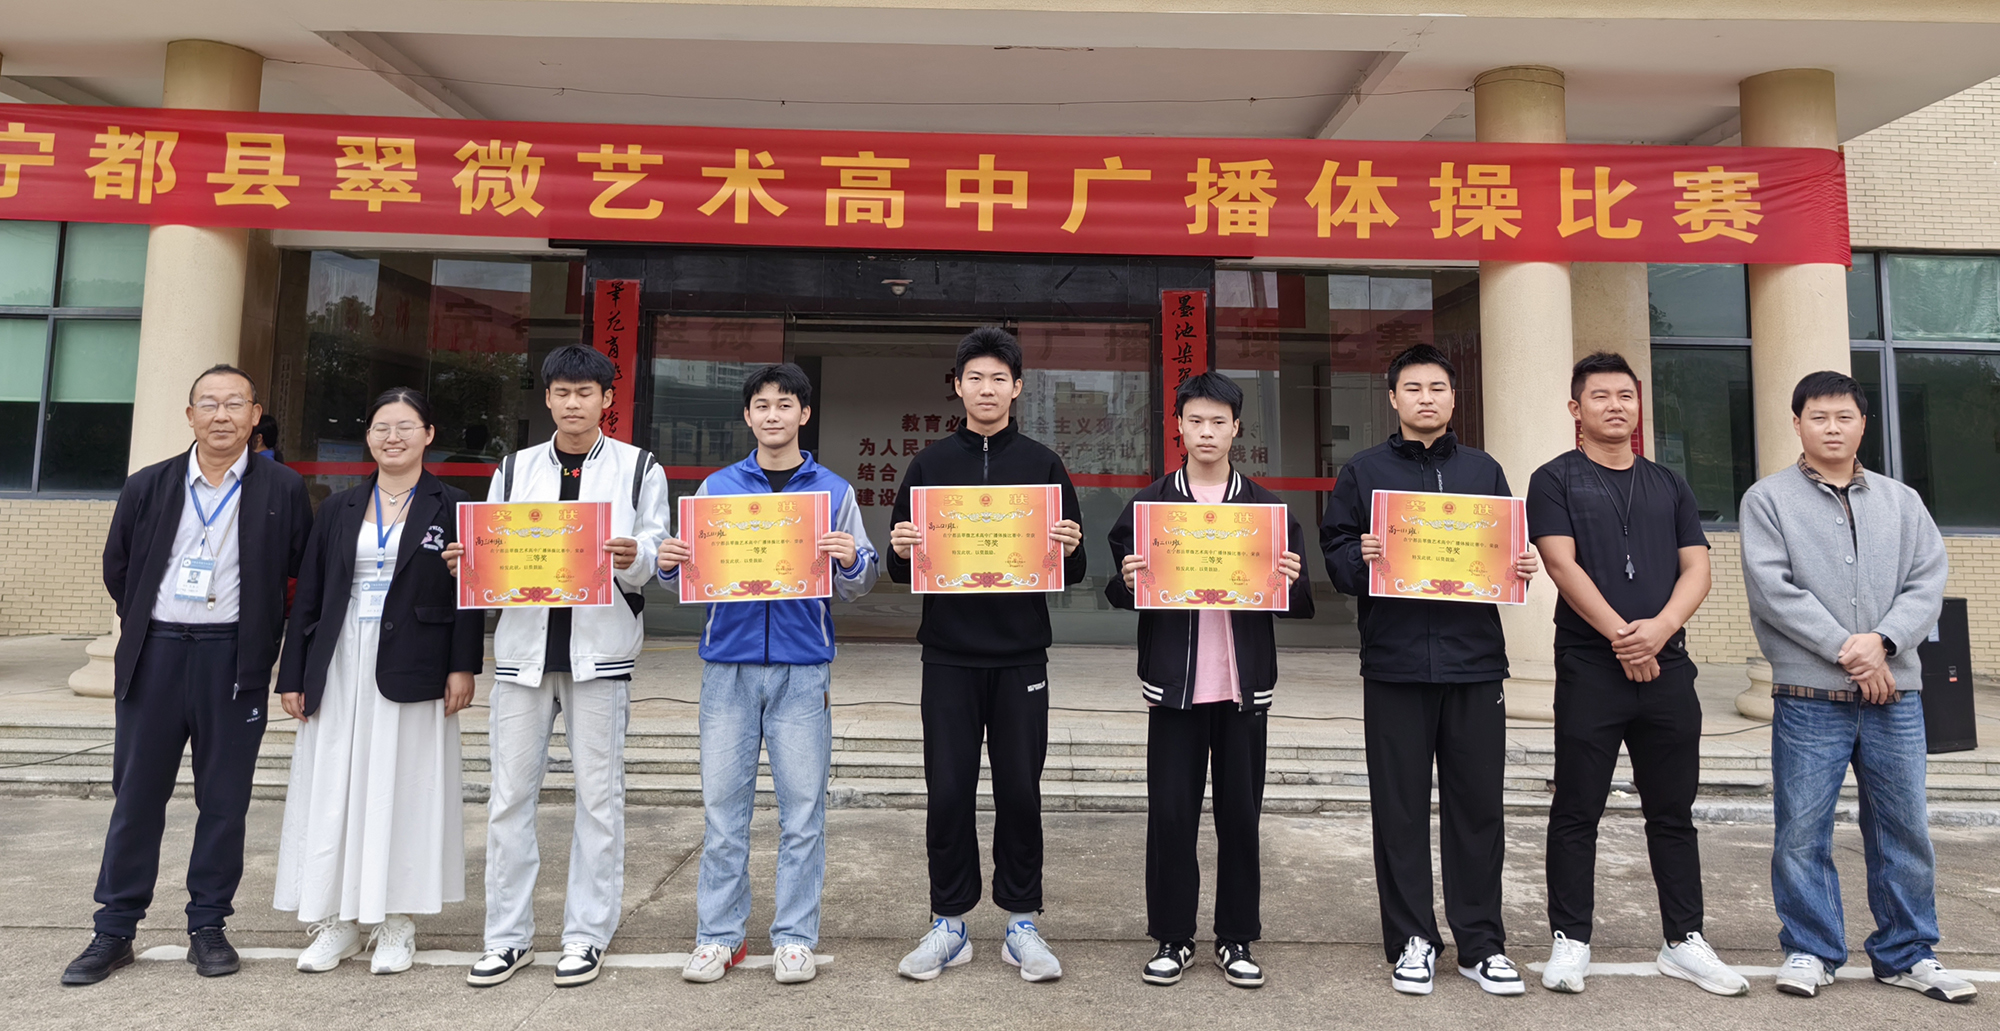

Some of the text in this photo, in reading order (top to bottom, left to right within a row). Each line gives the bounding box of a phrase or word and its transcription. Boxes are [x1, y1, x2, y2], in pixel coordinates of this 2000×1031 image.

[0, 122, 1761, 244] 宁都县翠微艺术高中广播体操比赛
[859, 438, 938, 457] 为人民
[857, 463, 897, 482] 结合
[857, 488, 896, 507] 建设
[526, 554, 548, 562] 三等奖
[1201, 556, 1223, 564] 三等奖
[1438, 546, 1460, 555] 二等奖
